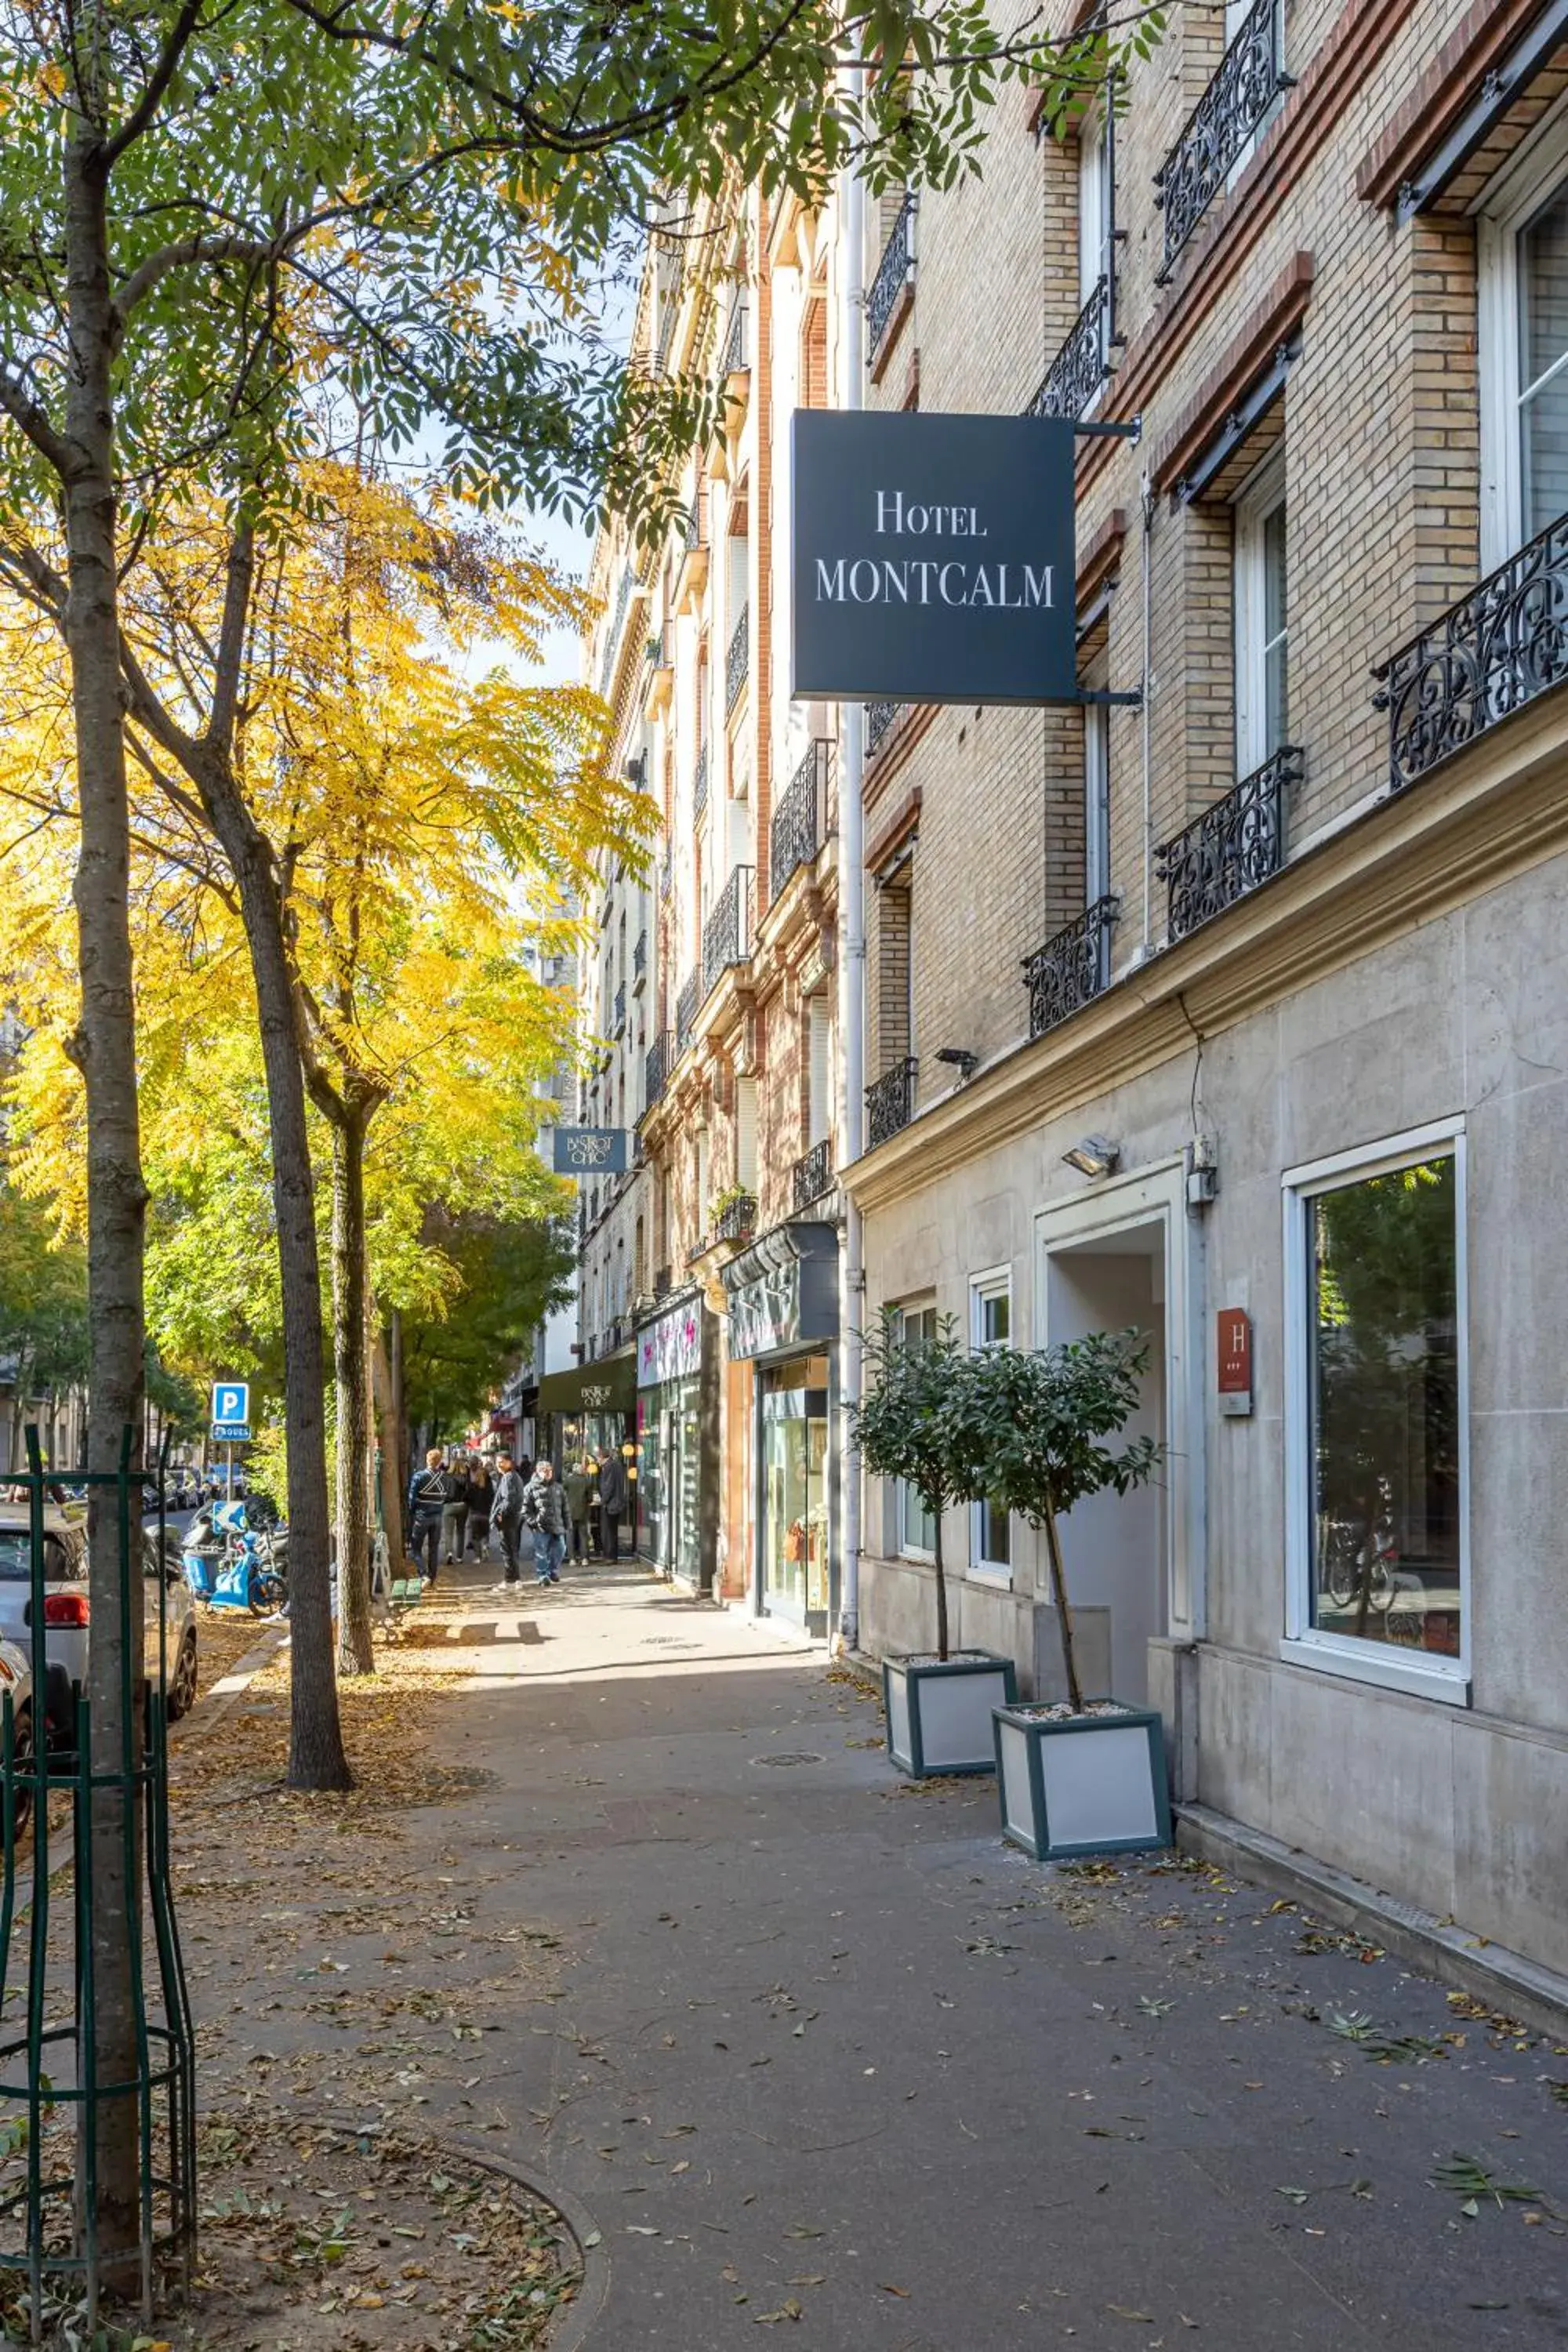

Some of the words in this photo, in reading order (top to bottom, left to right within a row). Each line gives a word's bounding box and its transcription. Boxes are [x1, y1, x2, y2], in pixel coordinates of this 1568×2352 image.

[815, 559, 1055, 608] MONTCALM
[1232, 1323, 1245, 1352] H
[223, 1392, 238, 1416] P
